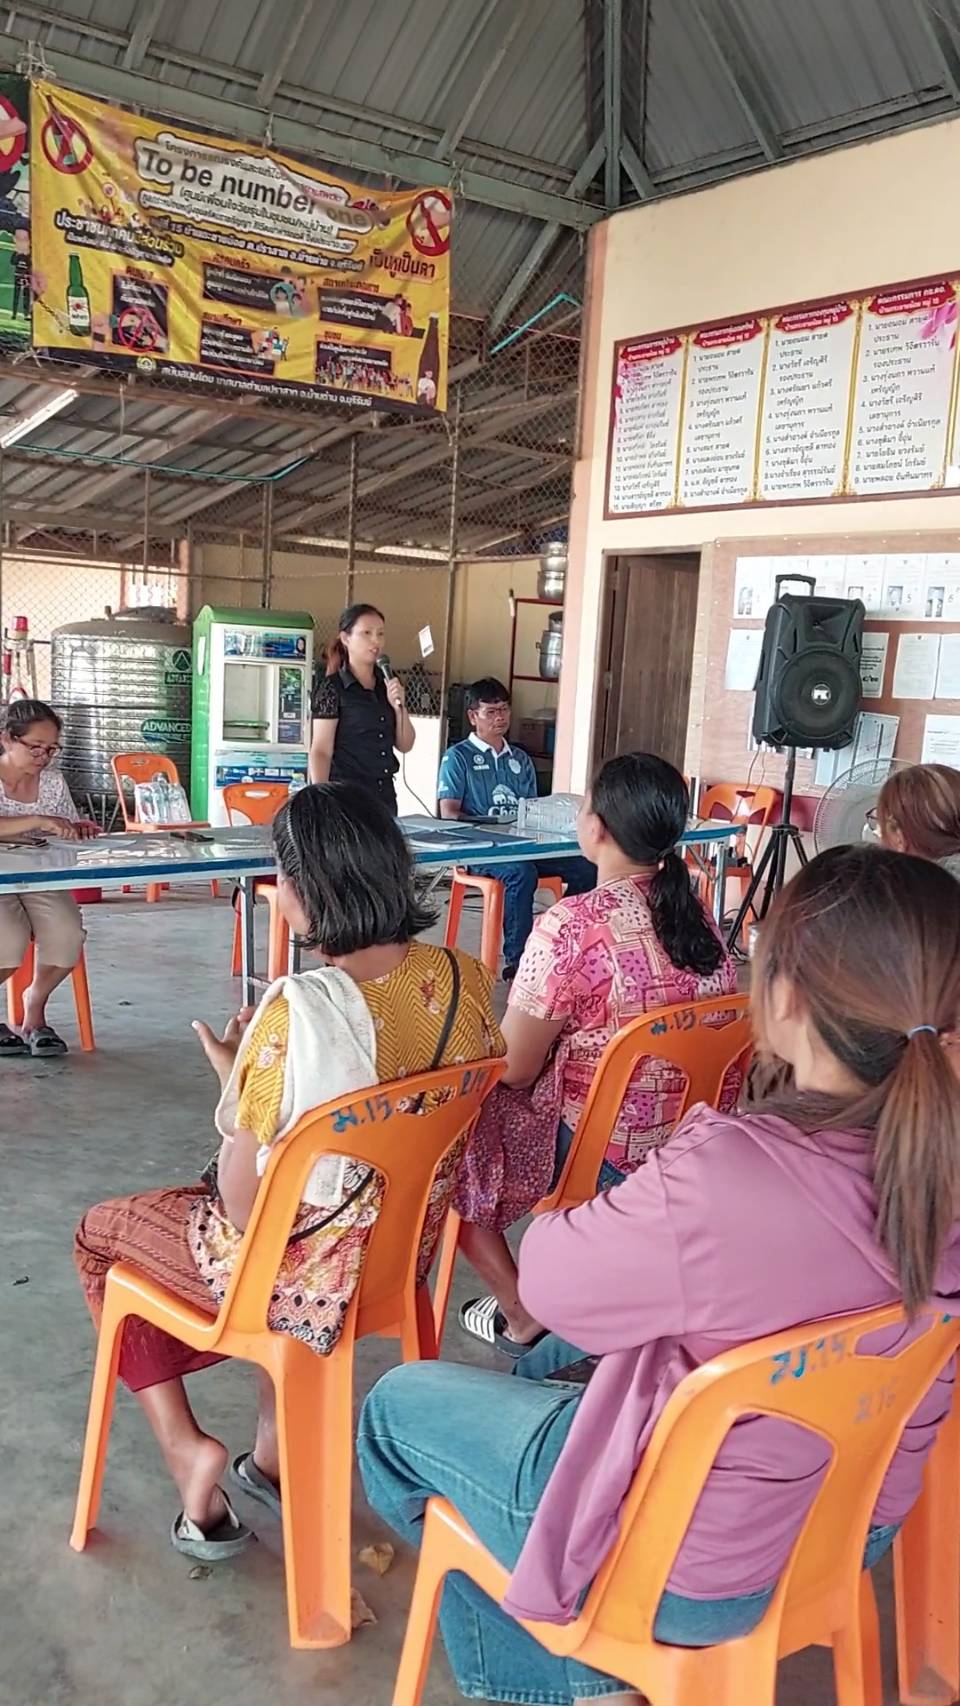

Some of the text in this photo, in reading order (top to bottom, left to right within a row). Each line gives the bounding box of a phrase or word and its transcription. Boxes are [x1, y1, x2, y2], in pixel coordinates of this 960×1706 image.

[142, 147, 368, 226] To be number one
[171, 222, 183, 232] 15
[161, 365, 214, 383] สนับสนุนโดย
[216, 377, 298, 397] เทศบาลตำบลปราสาท
[300, 388, 337, 402] อ.บ้านด่าน
[331, 1095, 394, 1132] ม.15
